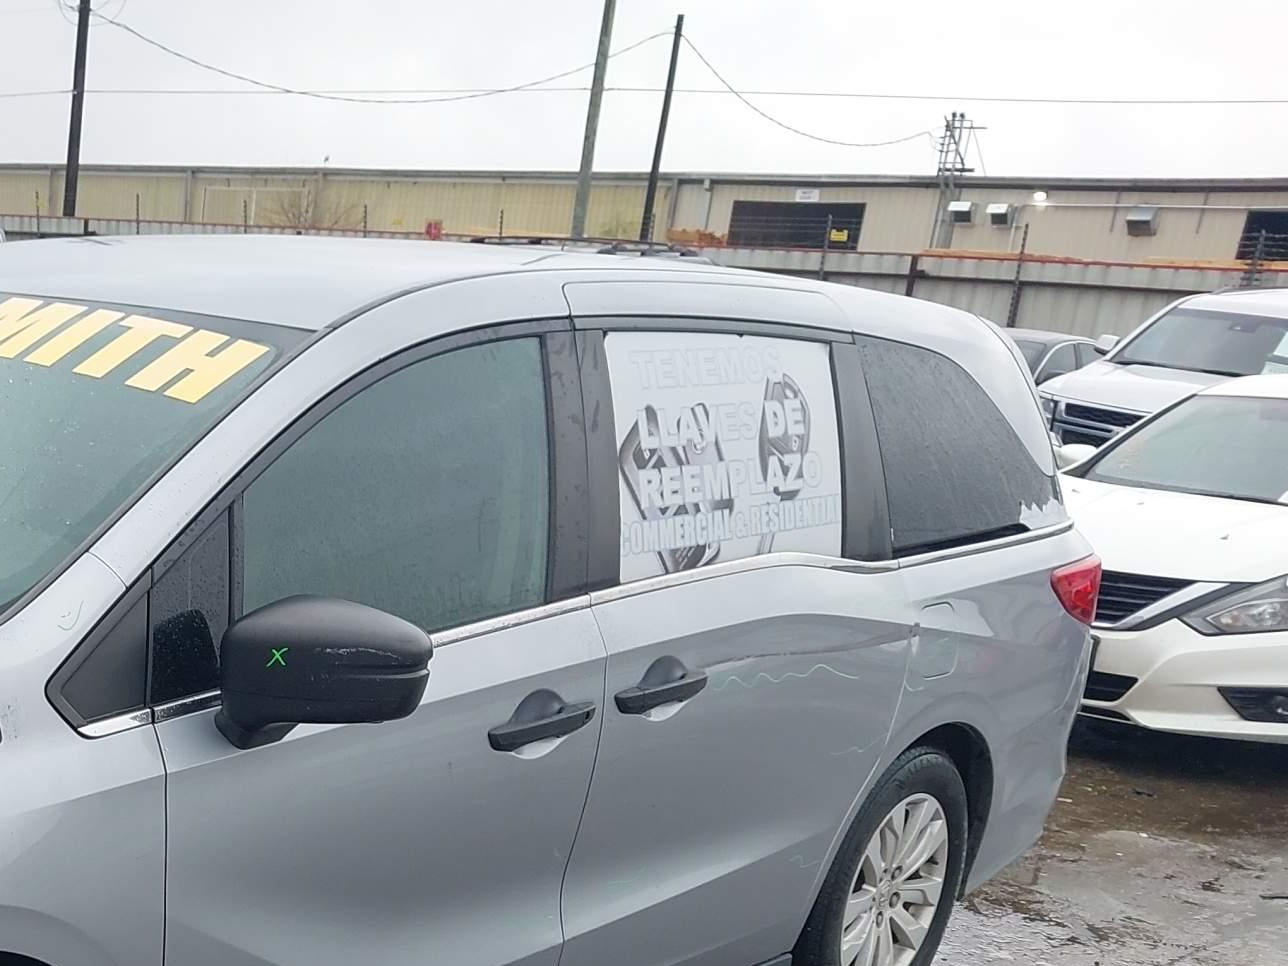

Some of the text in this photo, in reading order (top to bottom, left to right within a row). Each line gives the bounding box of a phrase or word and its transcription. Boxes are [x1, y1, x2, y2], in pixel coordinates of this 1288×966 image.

[629, 346, 783, 390] TENEMOS
[636, 399, 805, 449] LLAVES DE
[638, 450, 823, 509] REEMPLAZO
[622, 509, 734, 556] COMMERCIAL
[734, 512, 749, 539] &
